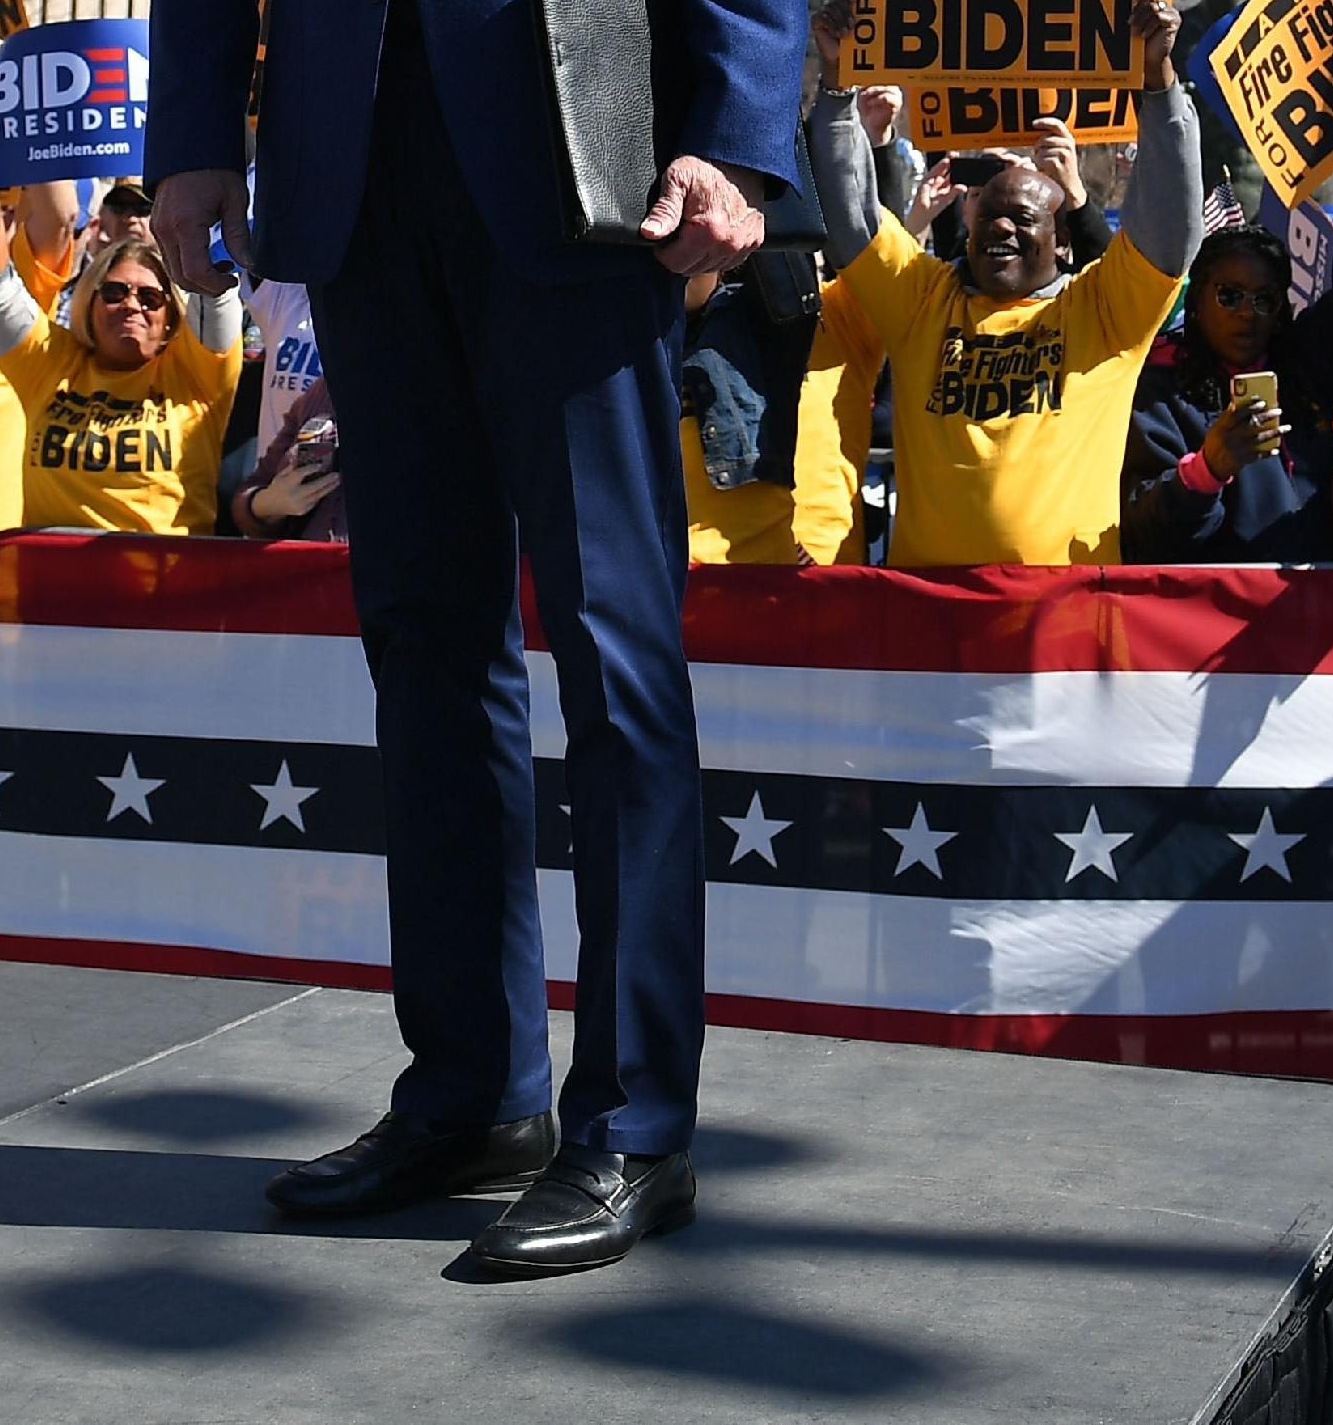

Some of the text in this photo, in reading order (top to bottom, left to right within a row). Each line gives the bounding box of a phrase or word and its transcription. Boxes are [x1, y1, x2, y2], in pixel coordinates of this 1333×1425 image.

[1239, 44, 1293, 121] Fire
[920, 91, 943, 138] FO
[27, 141, 130, 162] JoeBiden.com
[1254, 120, 1305, 189] FOR
[942, 371, 1062, 421] BIDEN
[41, 425, 172, 473] BIDEN
